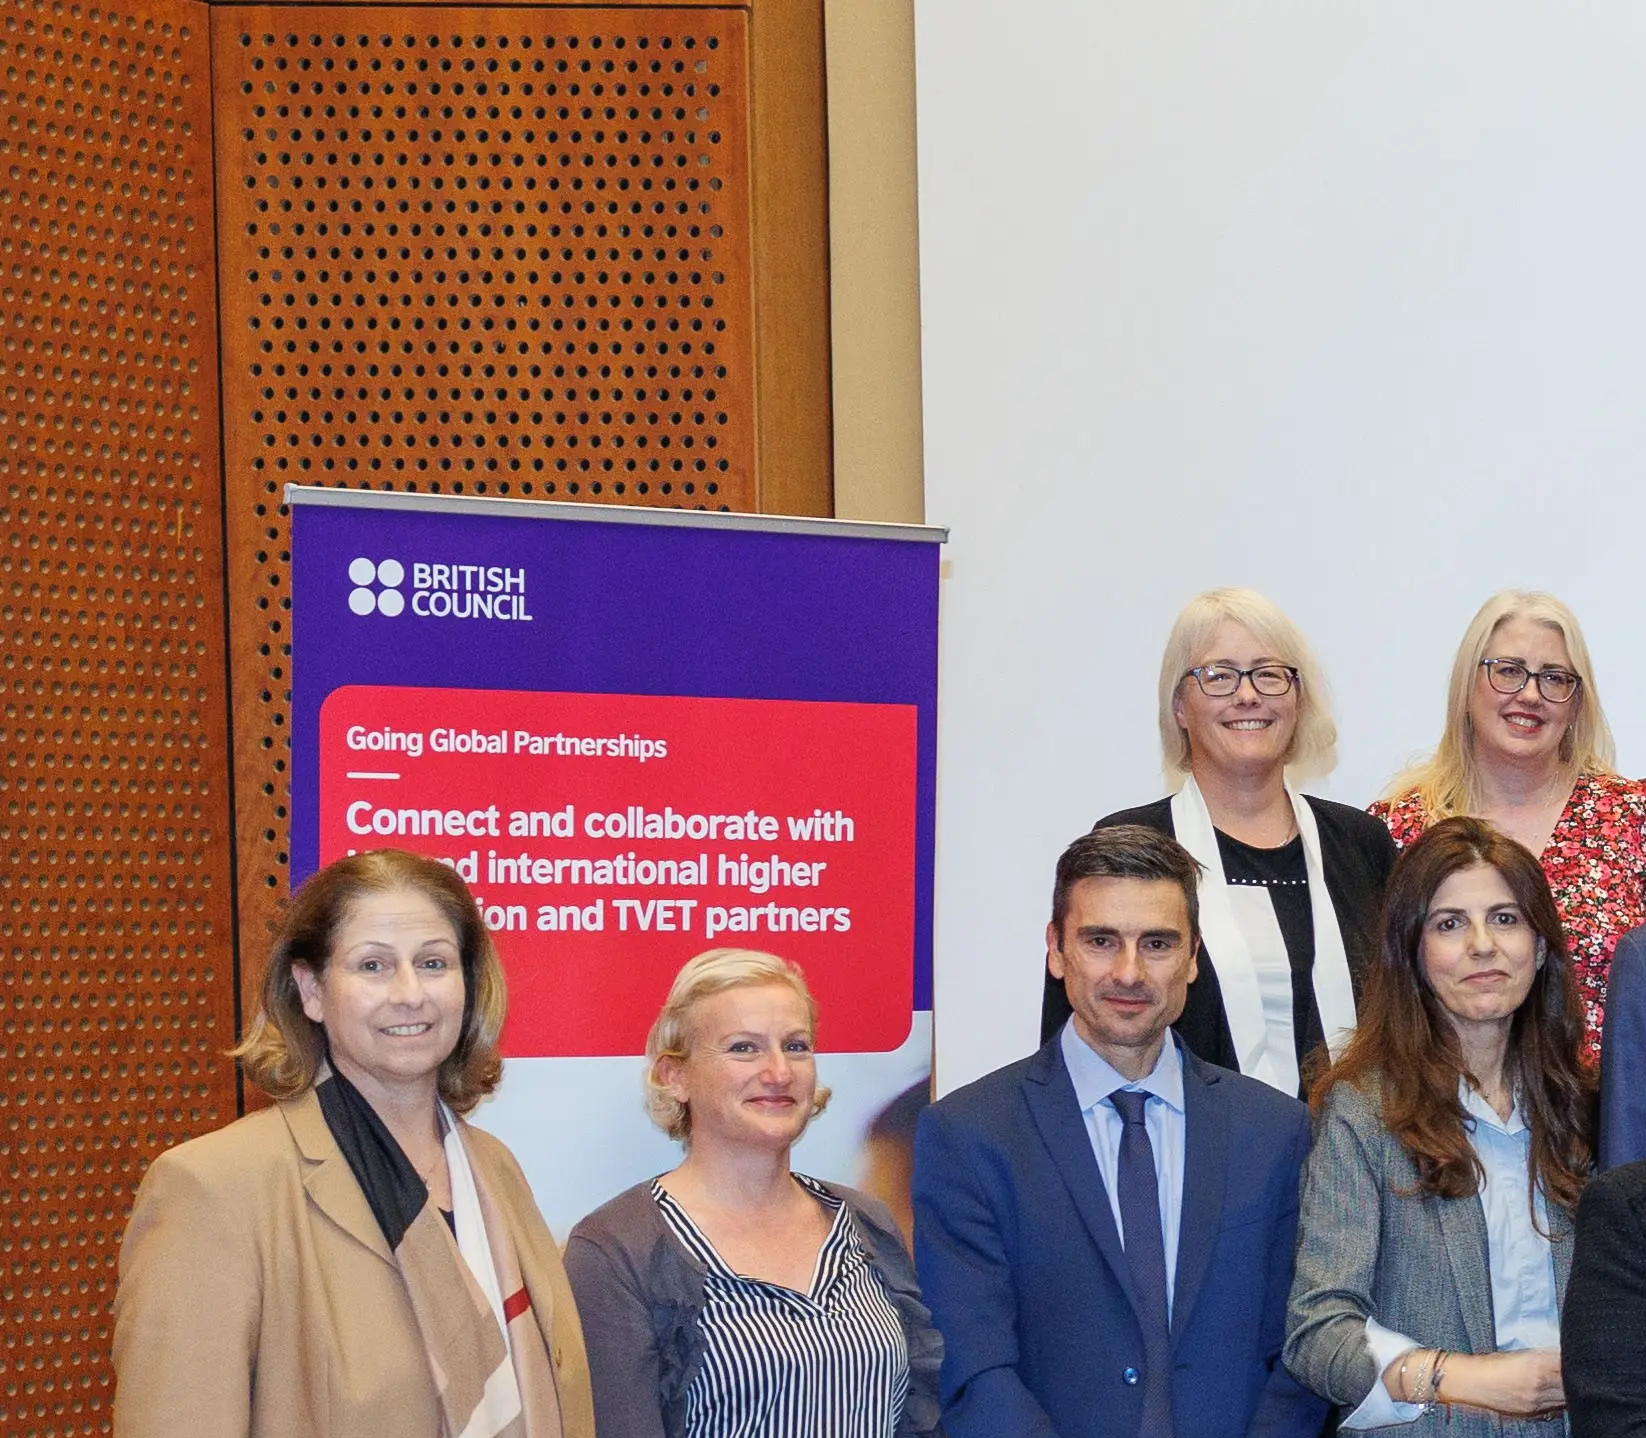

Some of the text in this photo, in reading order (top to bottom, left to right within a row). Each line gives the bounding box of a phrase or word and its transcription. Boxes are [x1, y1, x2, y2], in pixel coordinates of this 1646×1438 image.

[412, 562, 526, 593] BRITISH
[411, 589, 533, 622] COUNCIL
[346, 725, 668, 761] Going Global Partnerships
[346, 800, 856, 844] Connect and collaborate with
[487, 848, 708, 887] international
[718, 852, 828, 895] higher
[536, 897, 605, 933] and
[611, 899, 698, 932] TVET
[705, 901, 853, 940] partners
